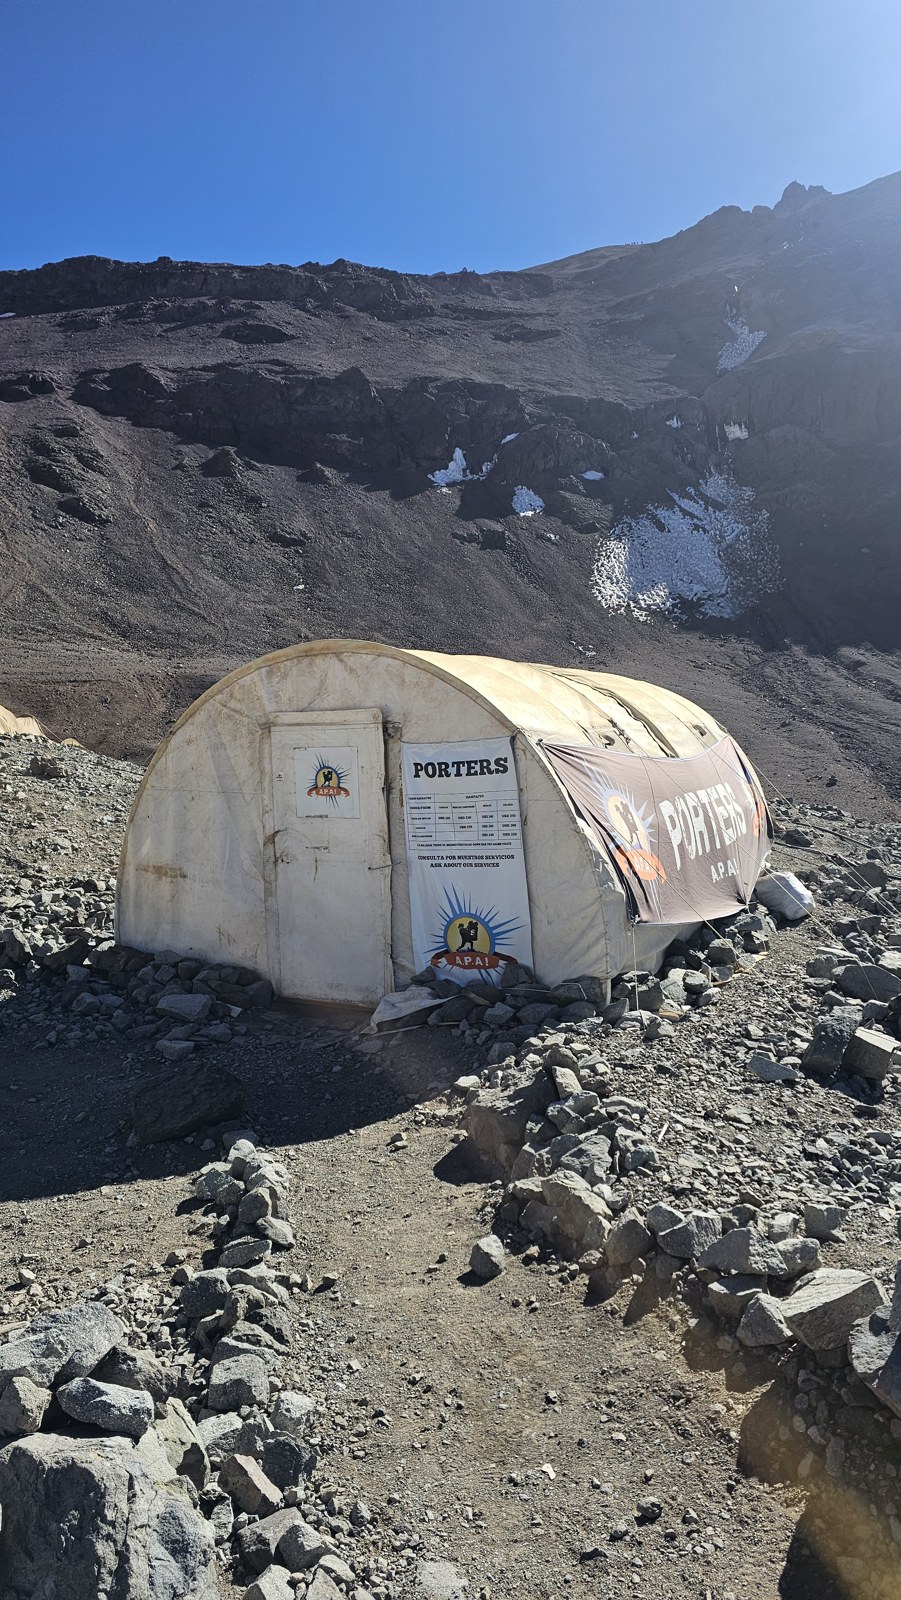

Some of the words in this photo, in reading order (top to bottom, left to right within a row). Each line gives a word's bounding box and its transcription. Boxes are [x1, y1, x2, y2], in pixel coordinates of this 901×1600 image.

[413, 757, 508, 778] PORTERS
[659, 782, 747, 871] PORTERS
[711, 858, 739, 883] A.P.A!
[455, 956, 489, 966] A.P.A!
